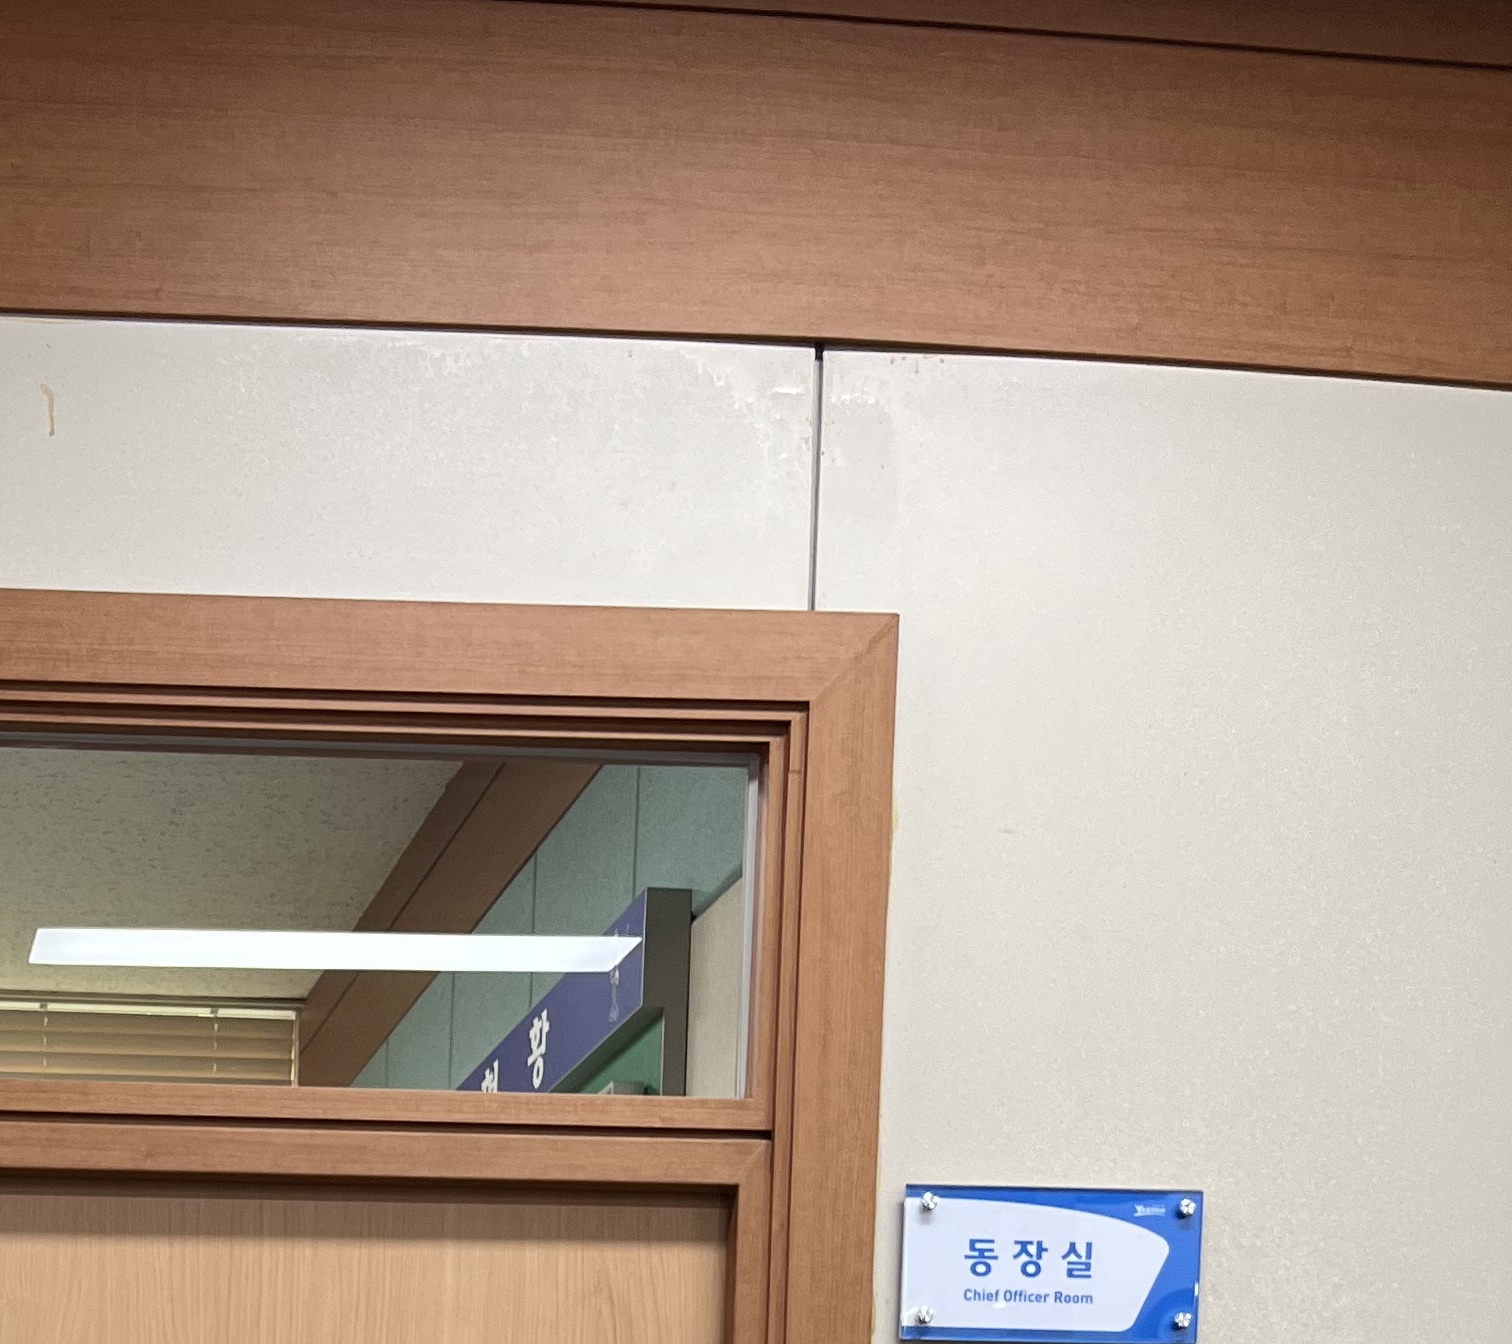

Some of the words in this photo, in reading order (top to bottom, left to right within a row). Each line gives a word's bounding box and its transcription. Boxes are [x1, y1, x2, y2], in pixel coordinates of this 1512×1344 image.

[963, 1238, 1093, 1279] 동장실
[963, 1288, 1000, 1302] Chief
[1003, 1289, 1050, 1303] Officer
[1054, 1291, 1094, 1305] Room
